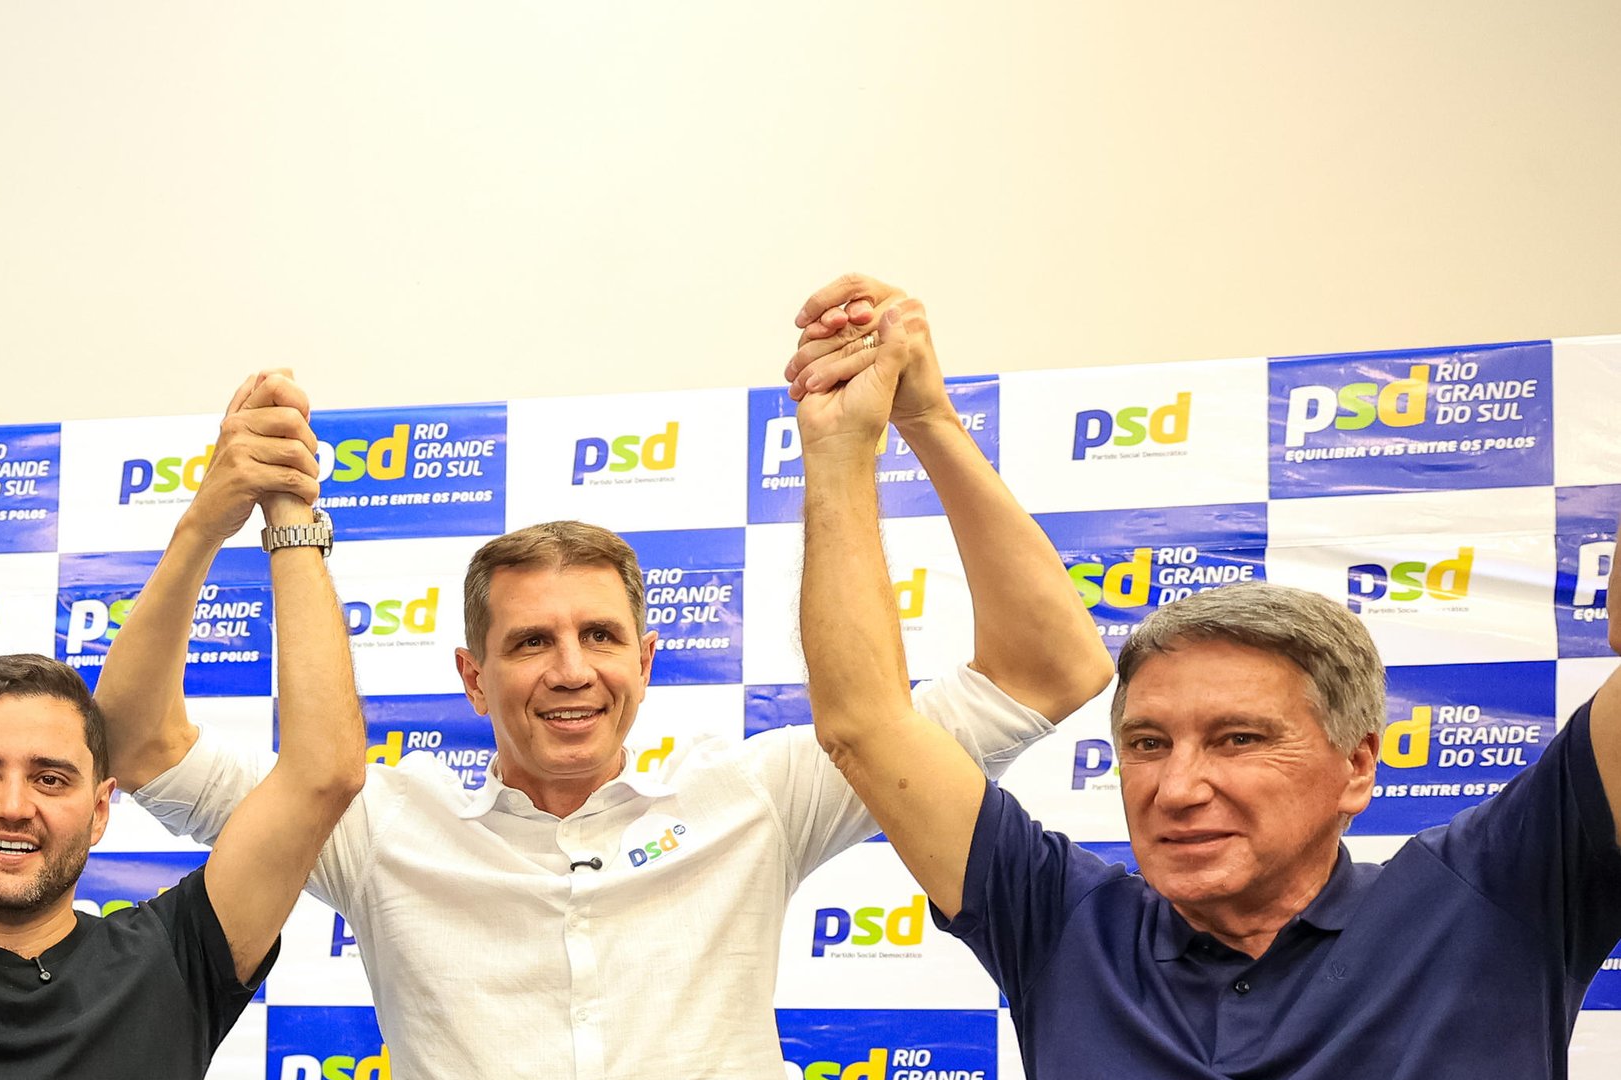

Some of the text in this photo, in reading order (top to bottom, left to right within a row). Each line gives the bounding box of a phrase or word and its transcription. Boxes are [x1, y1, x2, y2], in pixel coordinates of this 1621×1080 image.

[1435, 361, 1478, 381] RIO
[1436, 379, 1537, 402] GRANDE
[1286, 365, 1430, 448] psd
[1436, 403, 1522, 424] DO SUL
[414, 423, 448, 439] RIO
[1072, 392, 1191, 461] psd
[414, 440, 495, 459] GRANDE
[572, 422, 679, 485] psd
[1284, 437, 1535, 463] EQUILIBRA O RS ENTRE OS POLOS
[414, 460, 482, 478] DO SUL
[4, 480, 39, 496] SUL
[359, 491, 492, 506] O RS ENTRE OS POLOS
[8, 509, 47, 521] POLOS
[1157, 547, 1199, 564] RIO
[647, 568, 684, 584] RIO
[1159, 566, 1255, 586] GRANDE
[1347, 547, 1474, 614] psd
[647, 586, 732, 605] GRANDE
[646, 605, 721, 625] DO SUL
[666, 638, 730, 649] OS POLOS
[1437, 706, 1481, 725] RIO
[1438, 724, 1541, 745] GRANDE
[1439, 748, 1526, 767] DO SUL
[1371, 784, 1484, 797] O RS ENTRE OS
[812, 895, 928, 957] psd
[893, 1050, 930, 1066] RIO
